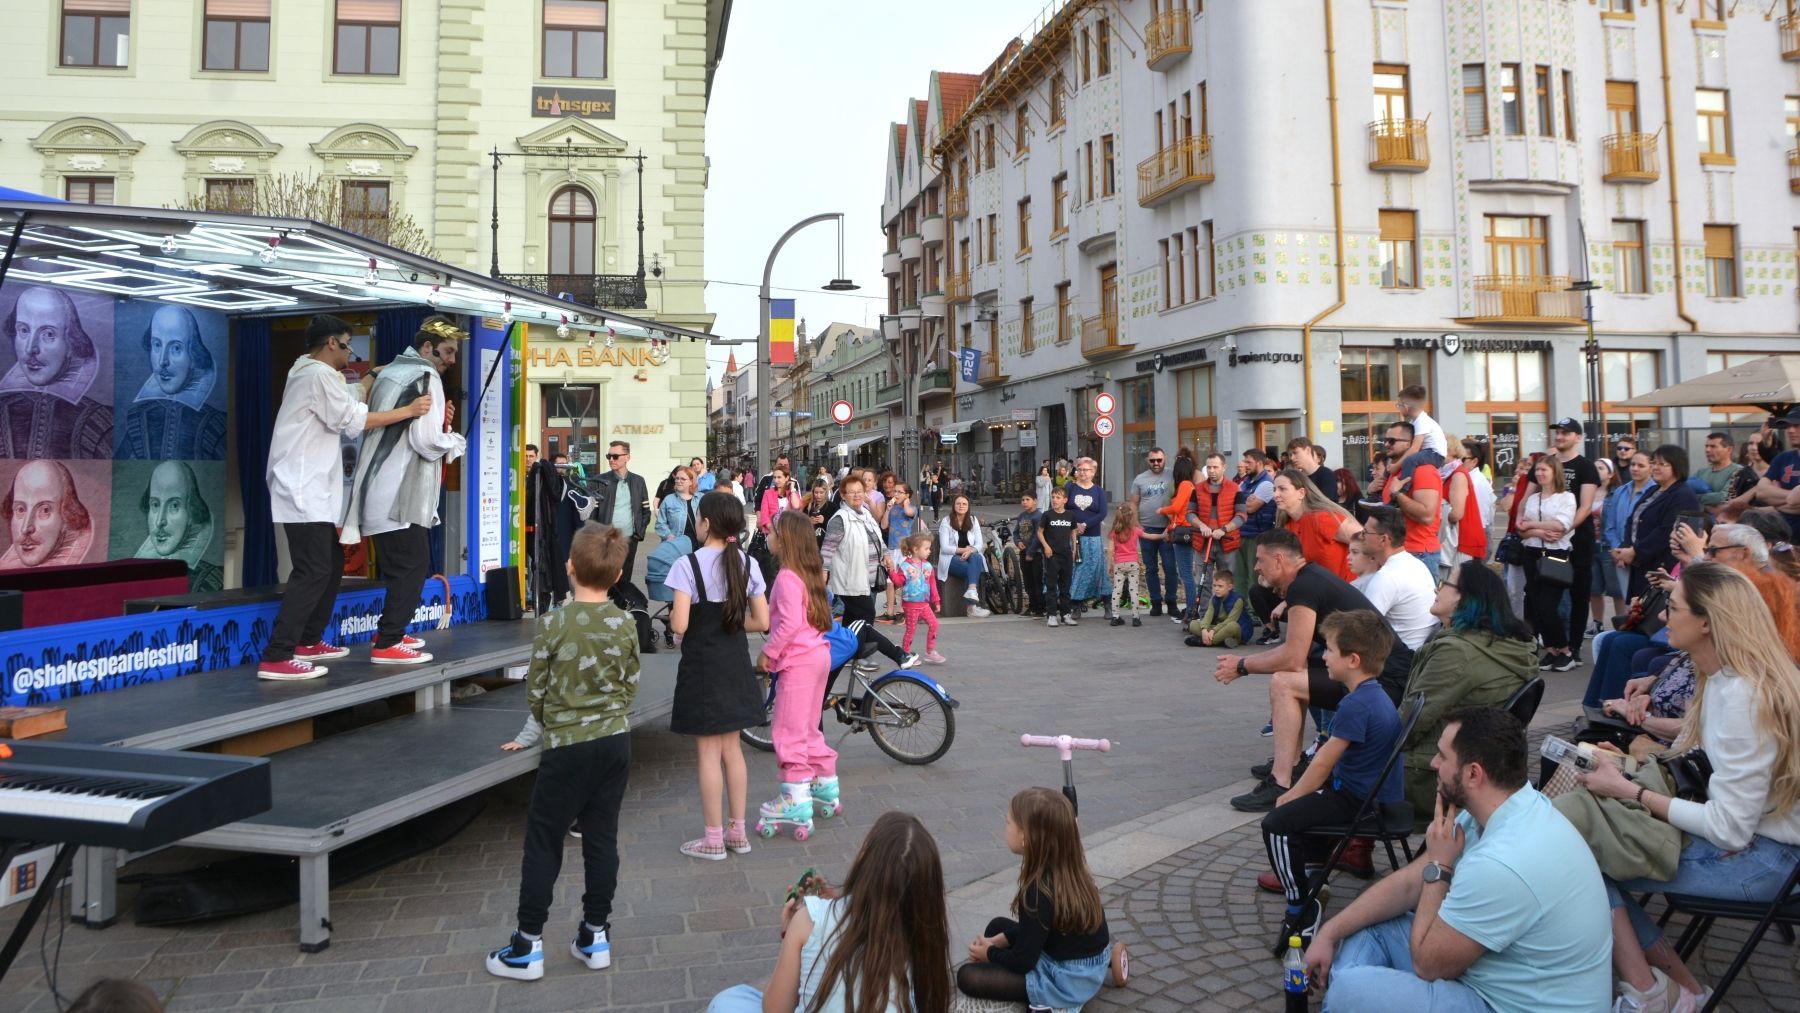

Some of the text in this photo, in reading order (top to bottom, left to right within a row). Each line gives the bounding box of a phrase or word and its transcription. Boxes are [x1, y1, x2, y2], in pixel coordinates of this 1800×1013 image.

[578, 346, 661, 366] BANK
[612, 424, 641, 435] ATM
[1050, 519, 1072, 527] adidas
[13, 639, 199, 694] @shakespearefestival
